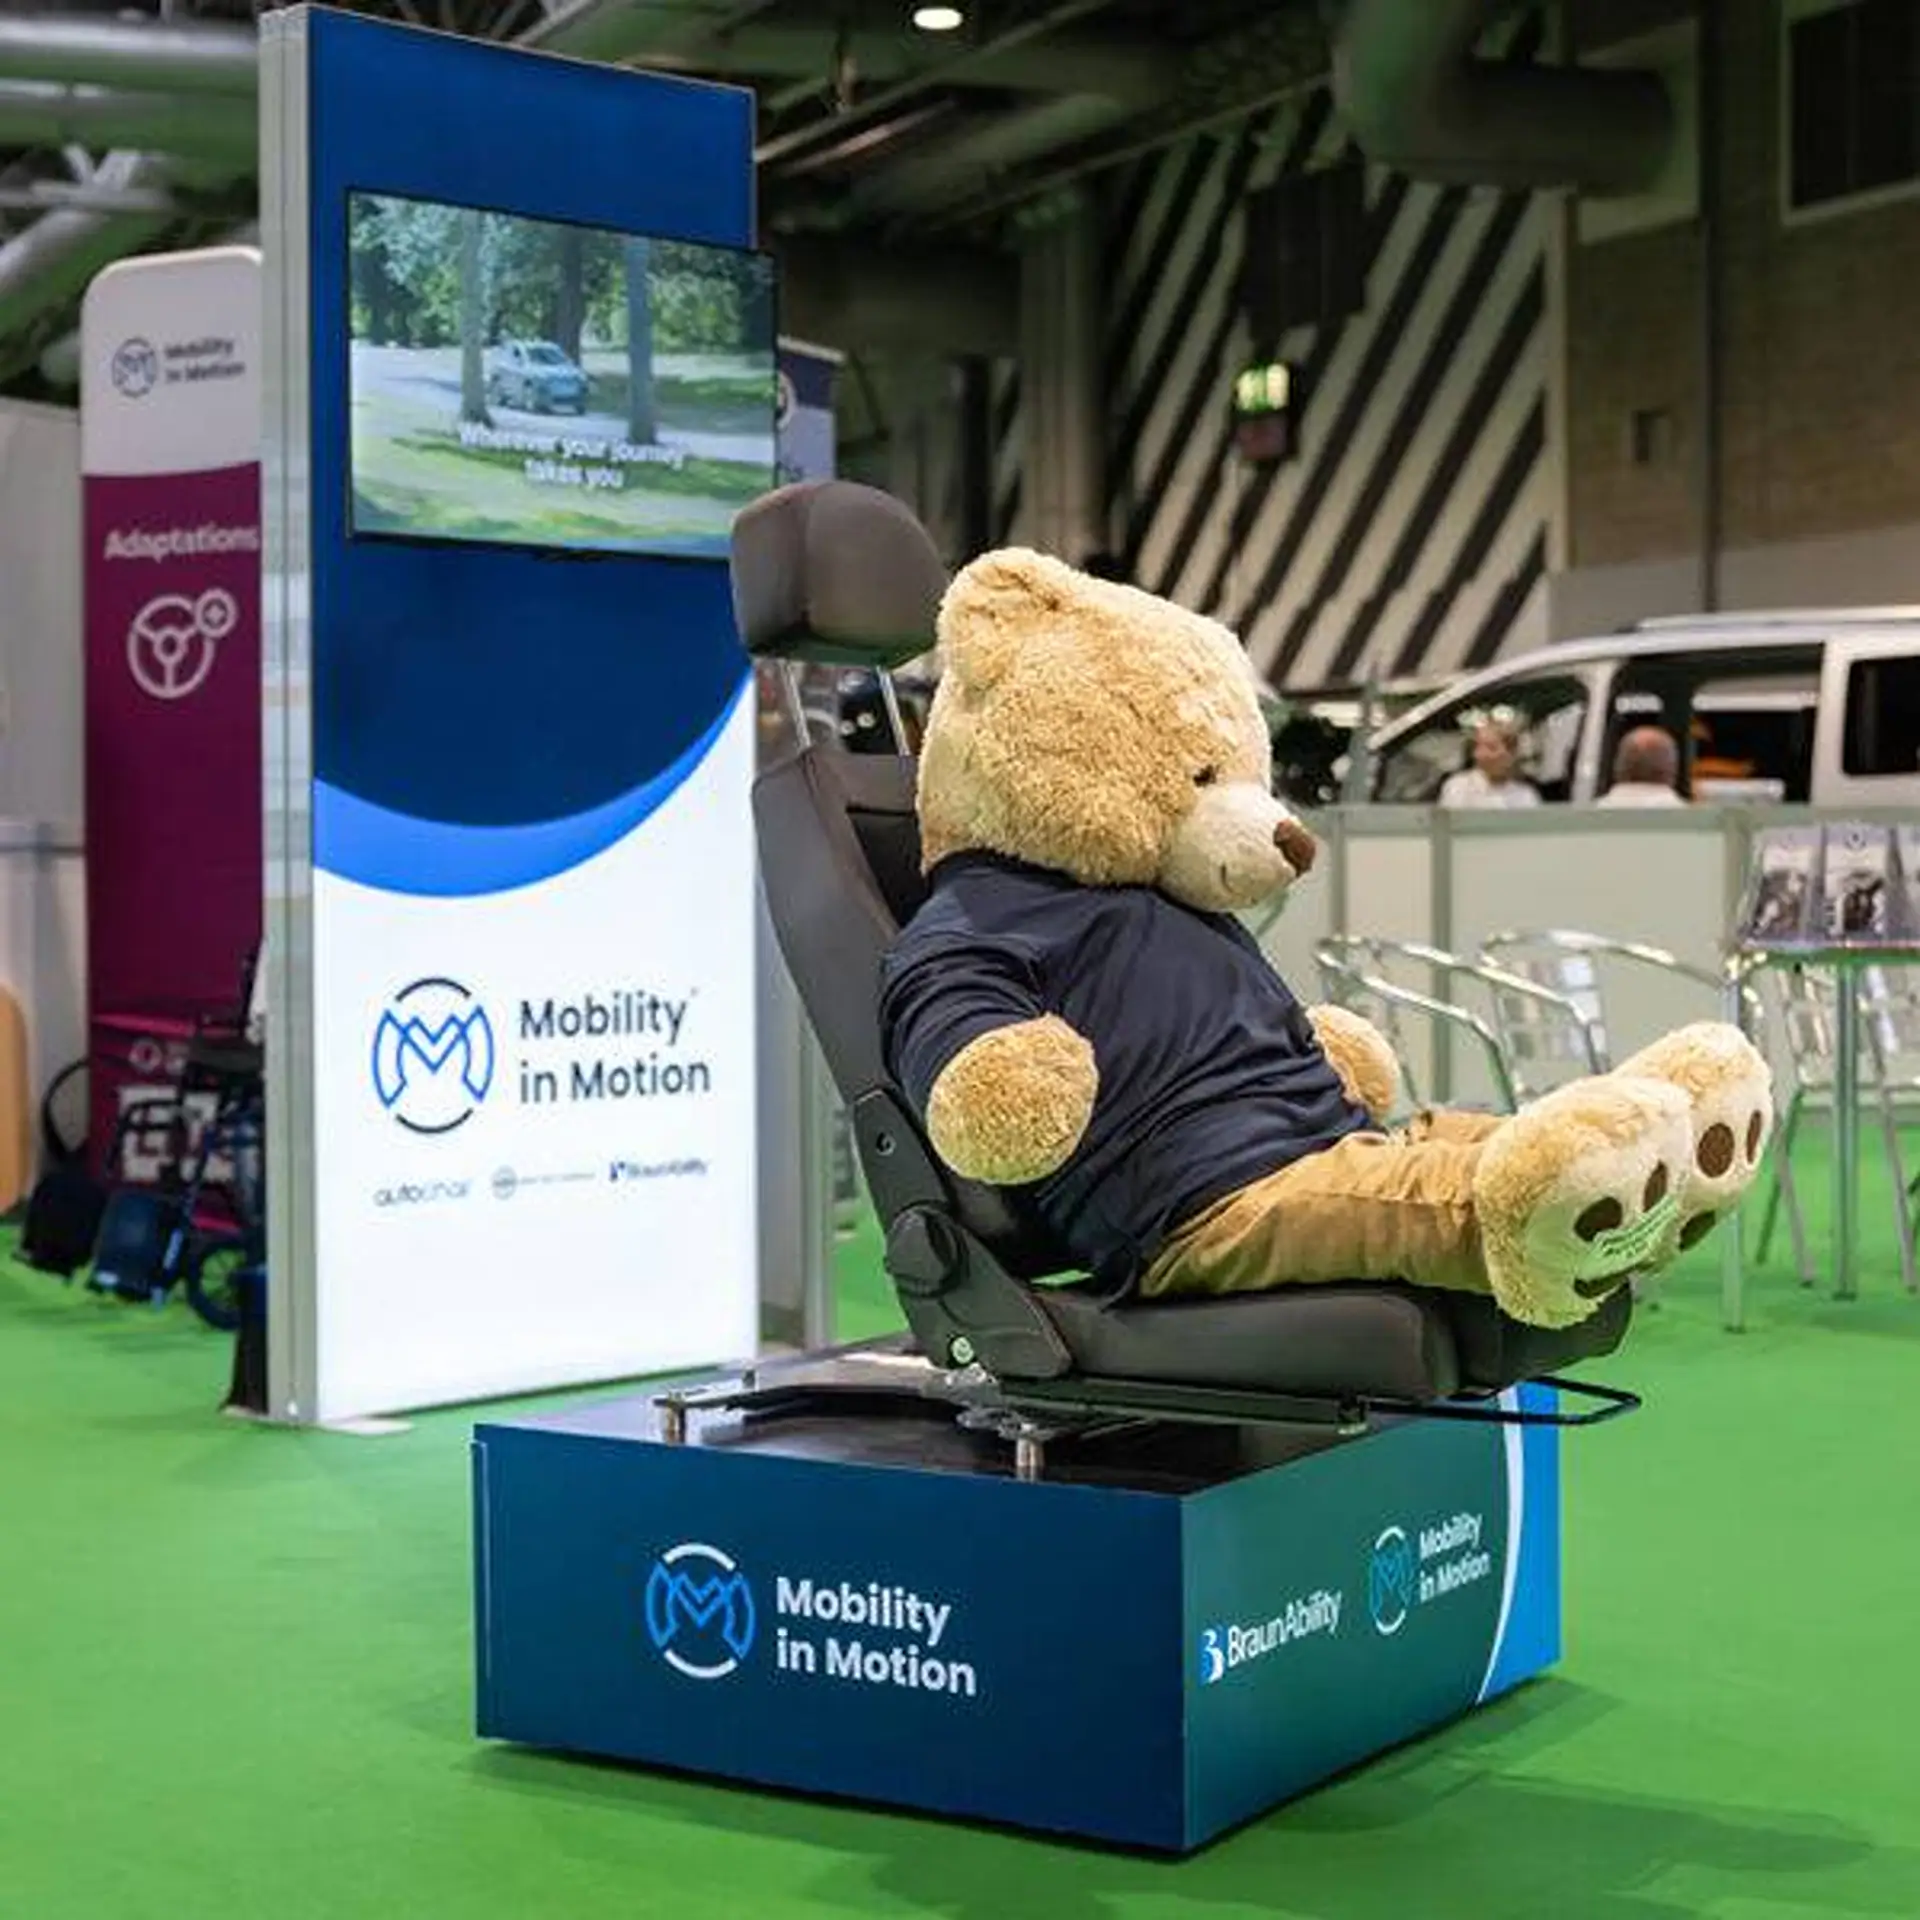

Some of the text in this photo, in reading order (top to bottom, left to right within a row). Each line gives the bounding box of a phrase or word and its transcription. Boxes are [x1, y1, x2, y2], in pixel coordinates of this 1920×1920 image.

[562, 437, 607, 459] your
[583, 467, 625, 490] you
[103, 527, 259, 563] Adaptations
[519, 990, 687, 1046] Mobility
[520, 1053, 711, 1103] in Motion
[1419, 1511, 1483, 1559] Mobility
[1420, 1550, 1491, 1603] in Motion
[776, 1576, 951, 1646] Mobility
[1227, 1590, 1343, 1667] BraunAbility
[776, 1628, 977, 1696] in Motion
